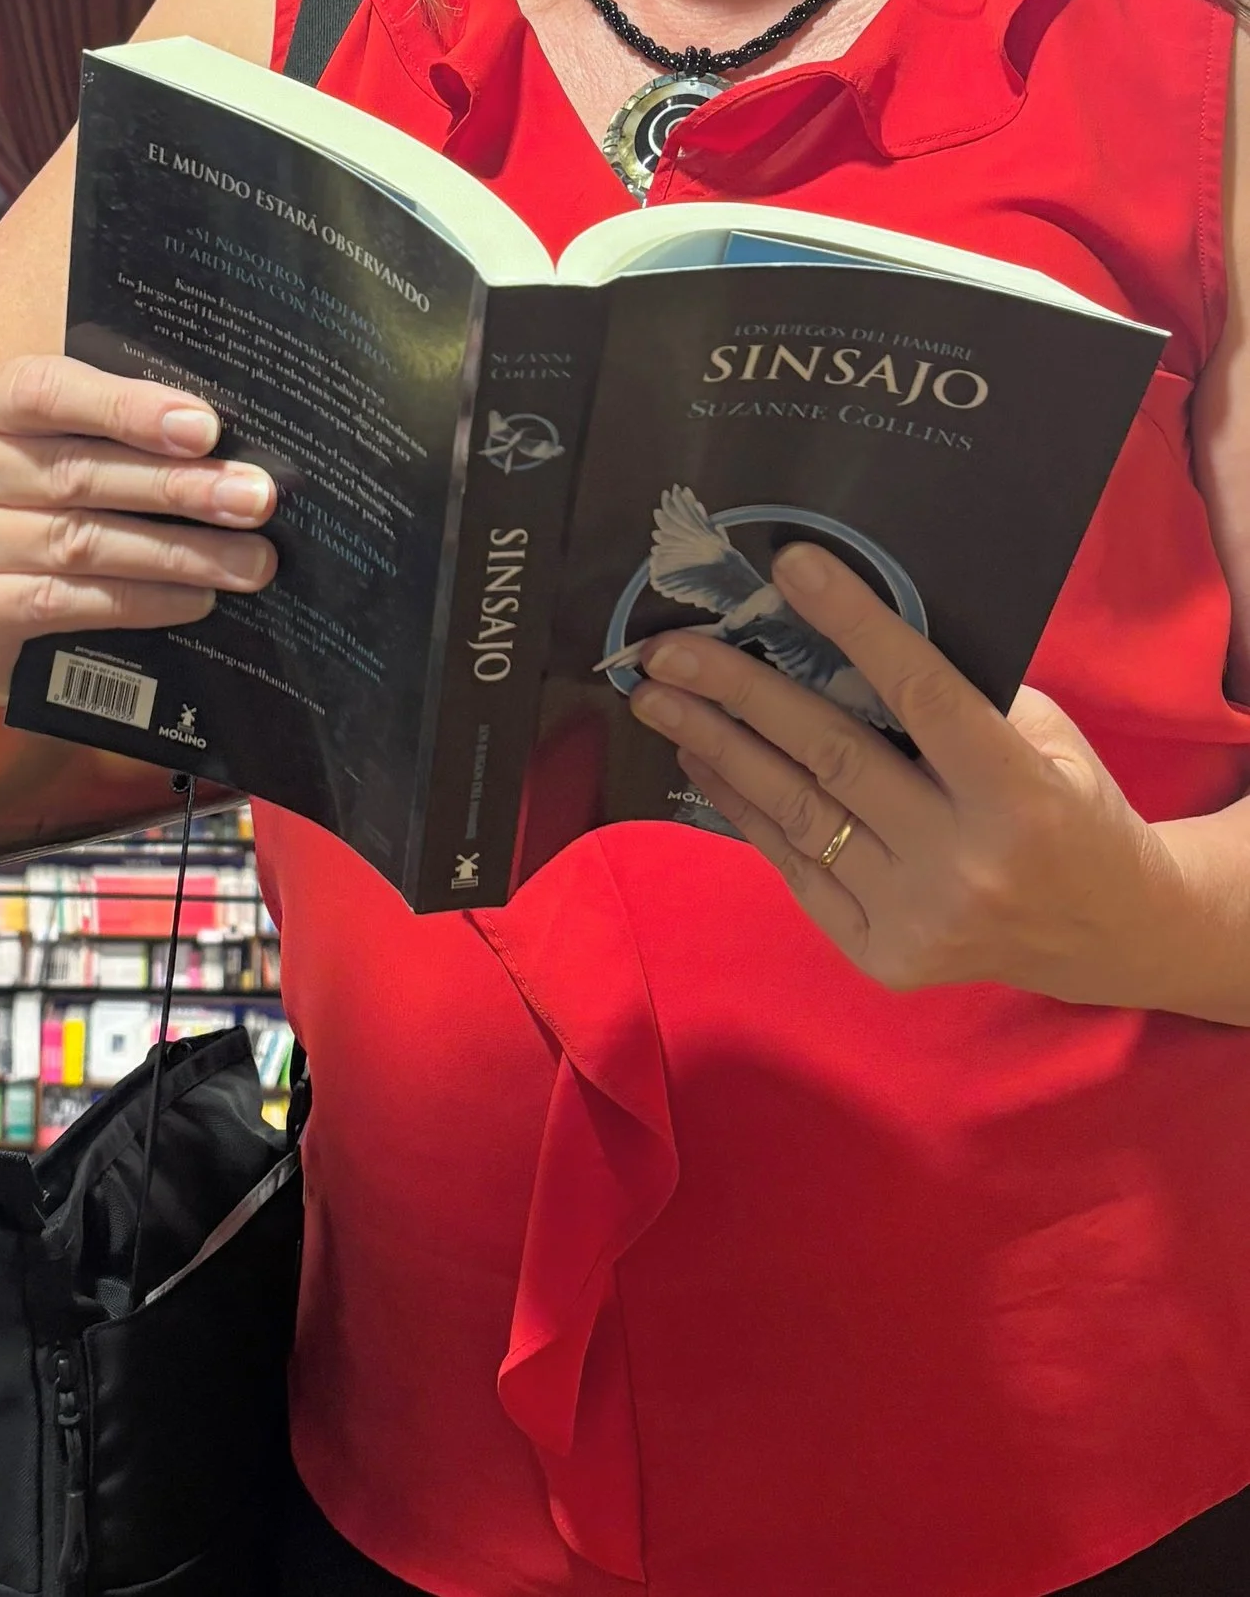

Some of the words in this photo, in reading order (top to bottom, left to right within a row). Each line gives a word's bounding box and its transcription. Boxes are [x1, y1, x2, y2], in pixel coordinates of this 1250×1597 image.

[147, 142, 168, 167] EL
[172, 152, 251, 201] MUNDO
[255, 189, 319, 236] ESTARÁ
[321, 224, 431, 314] OBSERVANDO
[703, 343, 989, 410] SINSAJO
[467, 528, 529, 682] SINSAJO
[158, 725, 207, 750] MOLINO
